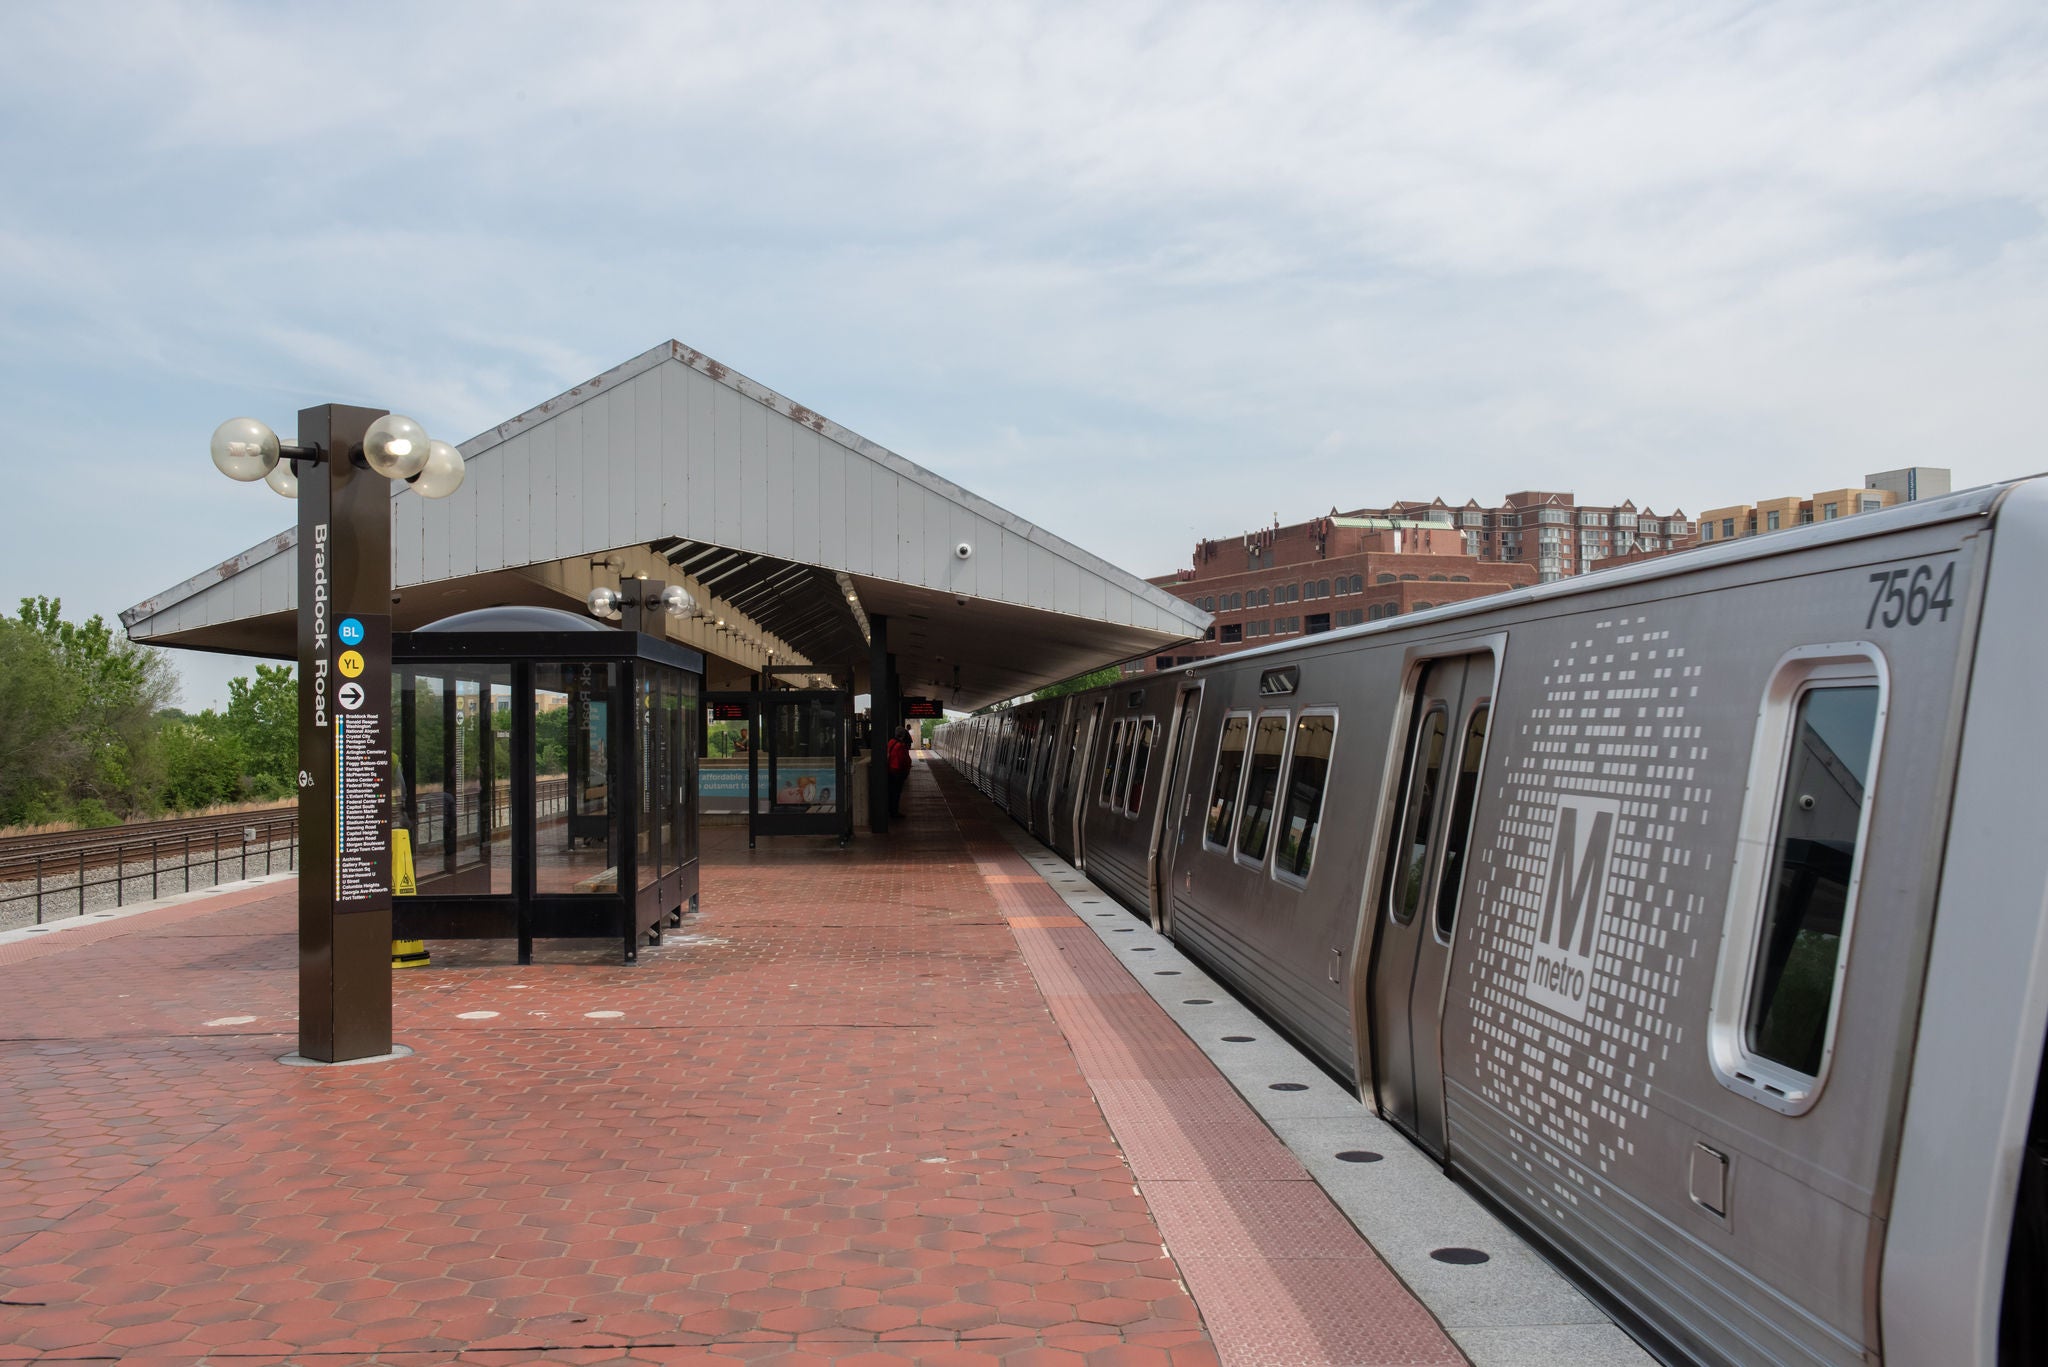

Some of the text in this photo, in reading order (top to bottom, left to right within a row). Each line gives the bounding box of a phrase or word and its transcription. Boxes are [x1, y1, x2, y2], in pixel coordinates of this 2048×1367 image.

[1866, 561, 1955, 630] 7564
[314, 524, 328, 727] Braddock Road
[343, 627, 359, 638] BL
[344, 659, 359, 670] YL
[1540, 806, 1614, 958] M
[1533, 954, 1584, 1001] metro
